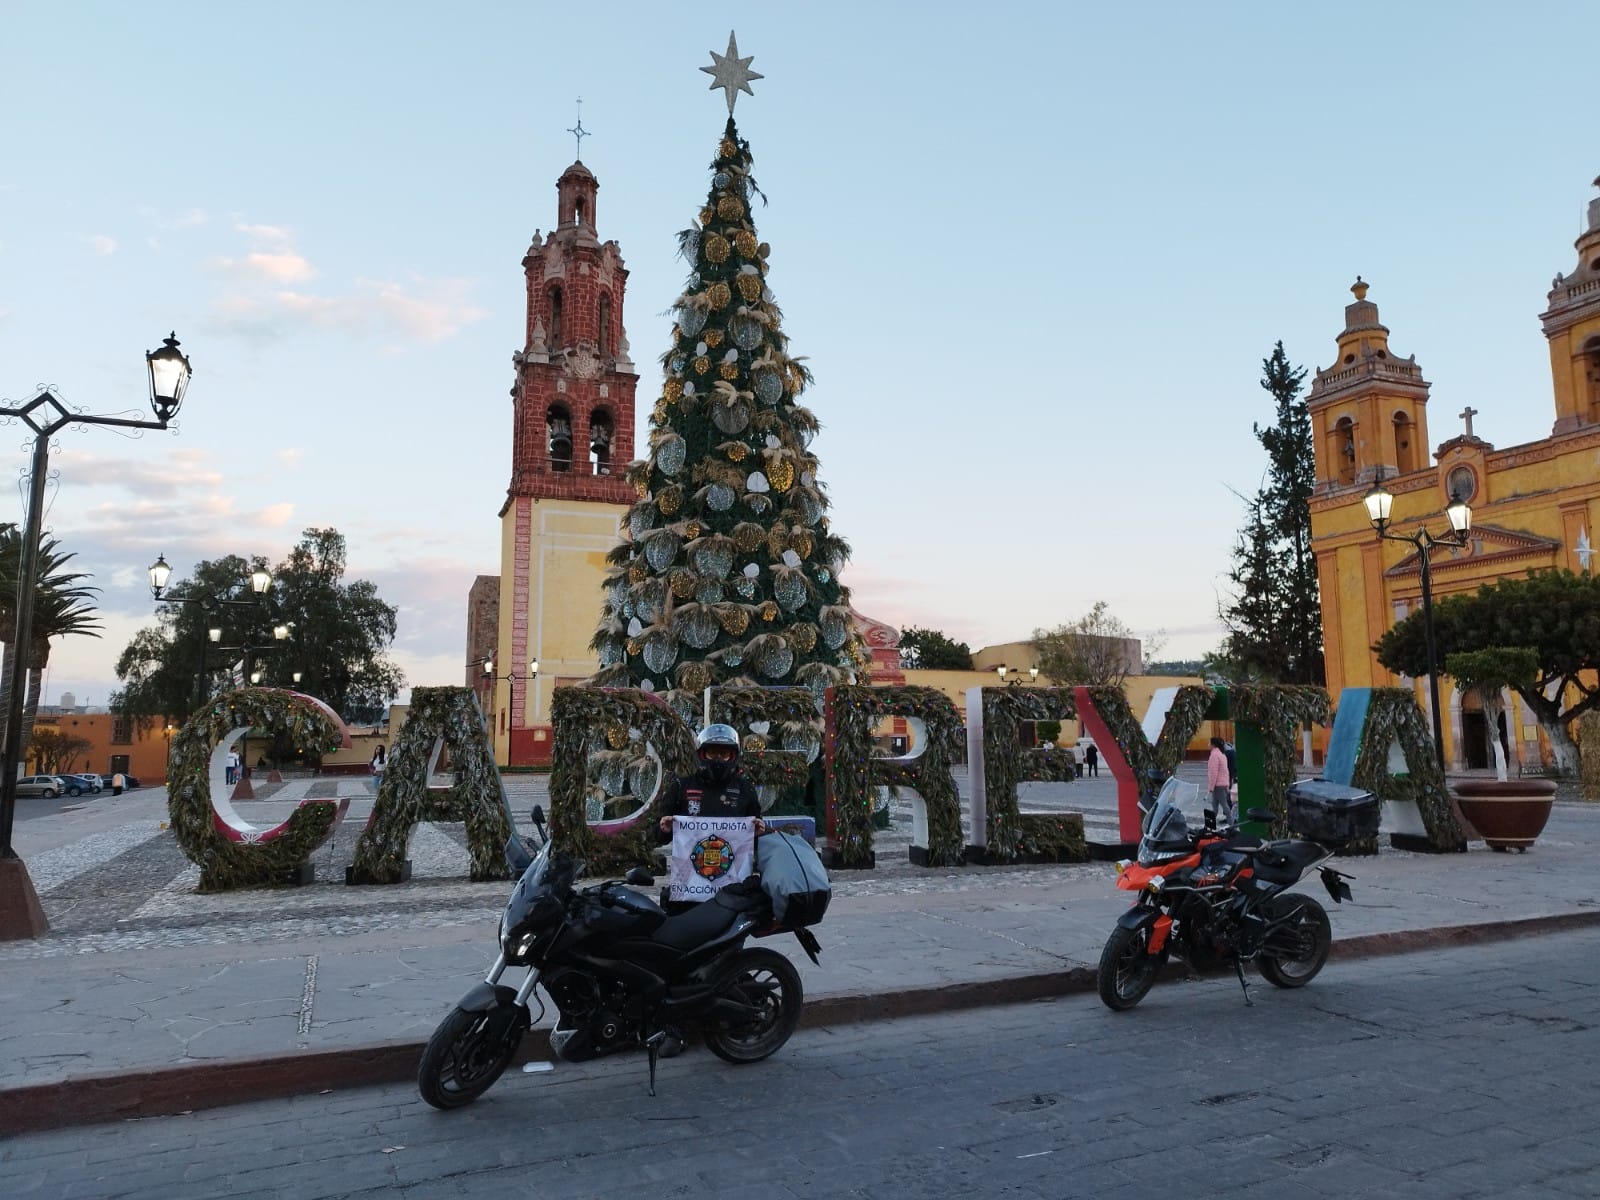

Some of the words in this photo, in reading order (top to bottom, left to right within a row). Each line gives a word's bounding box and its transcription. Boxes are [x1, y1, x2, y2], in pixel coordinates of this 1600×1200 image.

[679, 821, 709, 831] MOTO
[711, 821, 747, 831] TURISTA
[671, 883, 683, 893] EN
[684, 884, 717, 894] ACCIÓN
